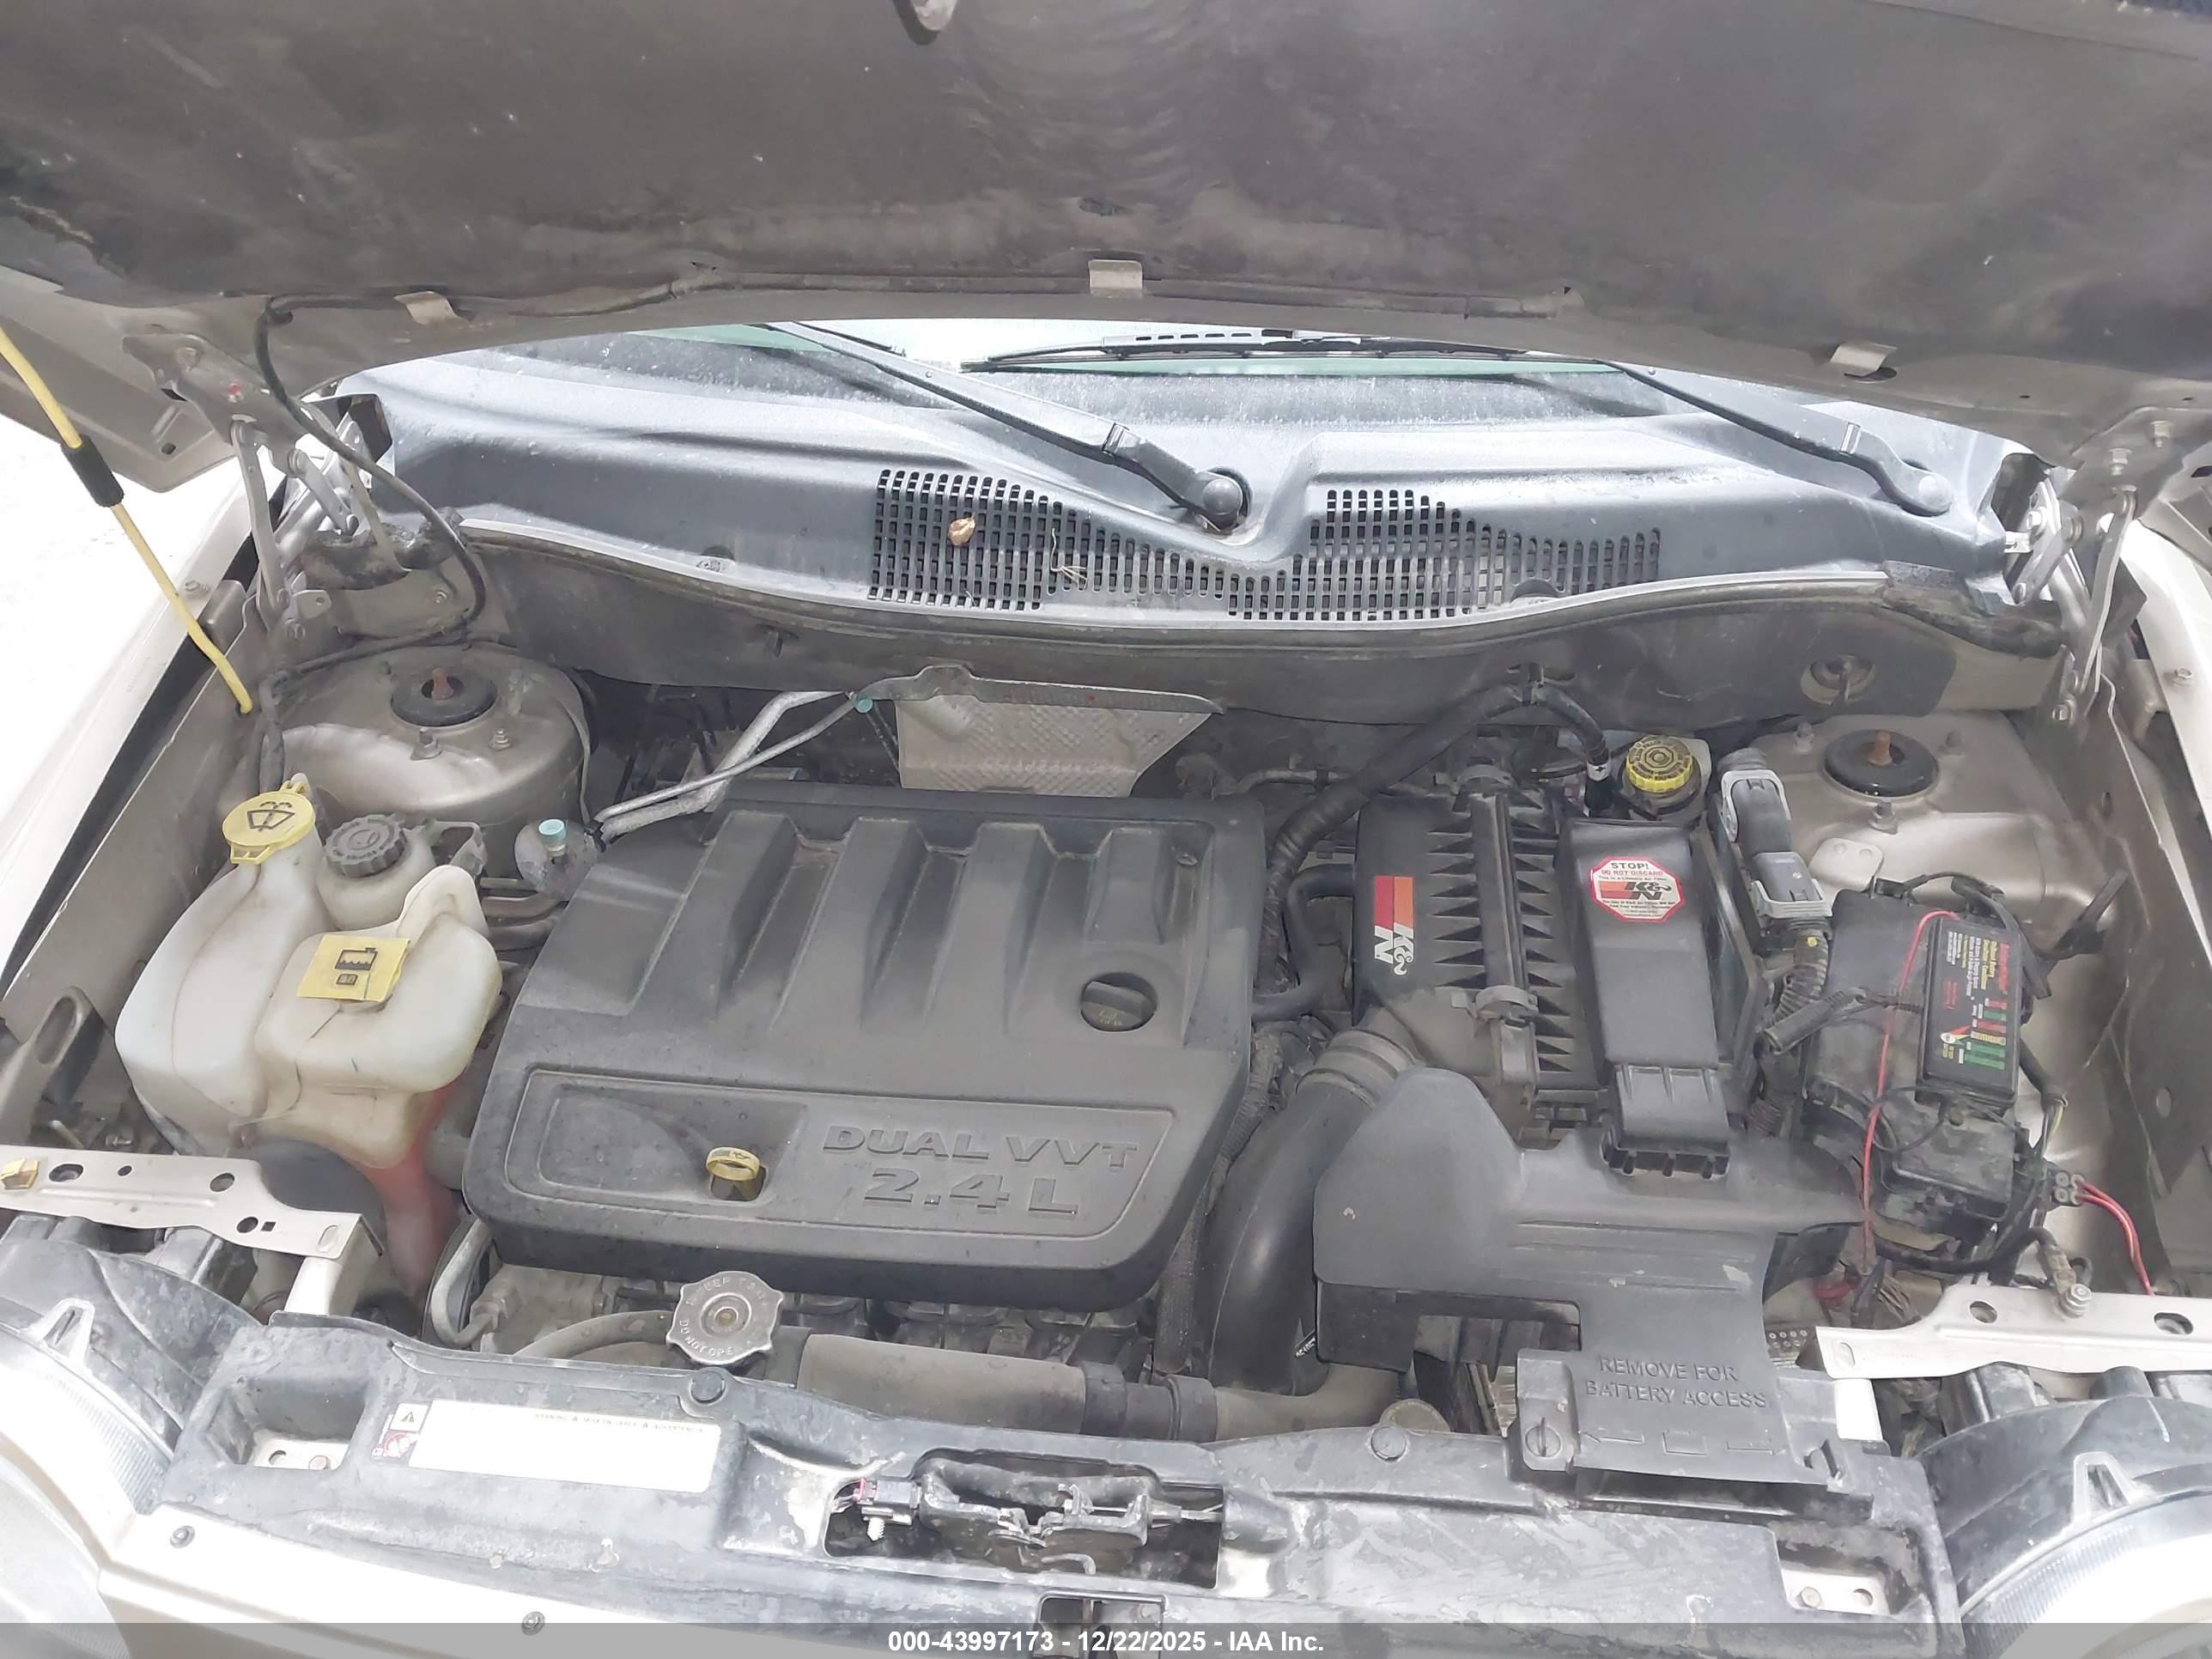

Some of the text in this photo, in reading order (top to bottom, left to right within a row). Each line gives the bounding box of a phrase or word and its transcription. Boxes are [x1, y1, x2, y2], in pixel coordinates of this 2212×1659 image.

[823, 1124, 1139, 1168] DUAL VVT
[1599, 1357, 1739, 1382] REMOVE FOR
[1586, 1380, 1767, 1409] BATTERY ACCESS
